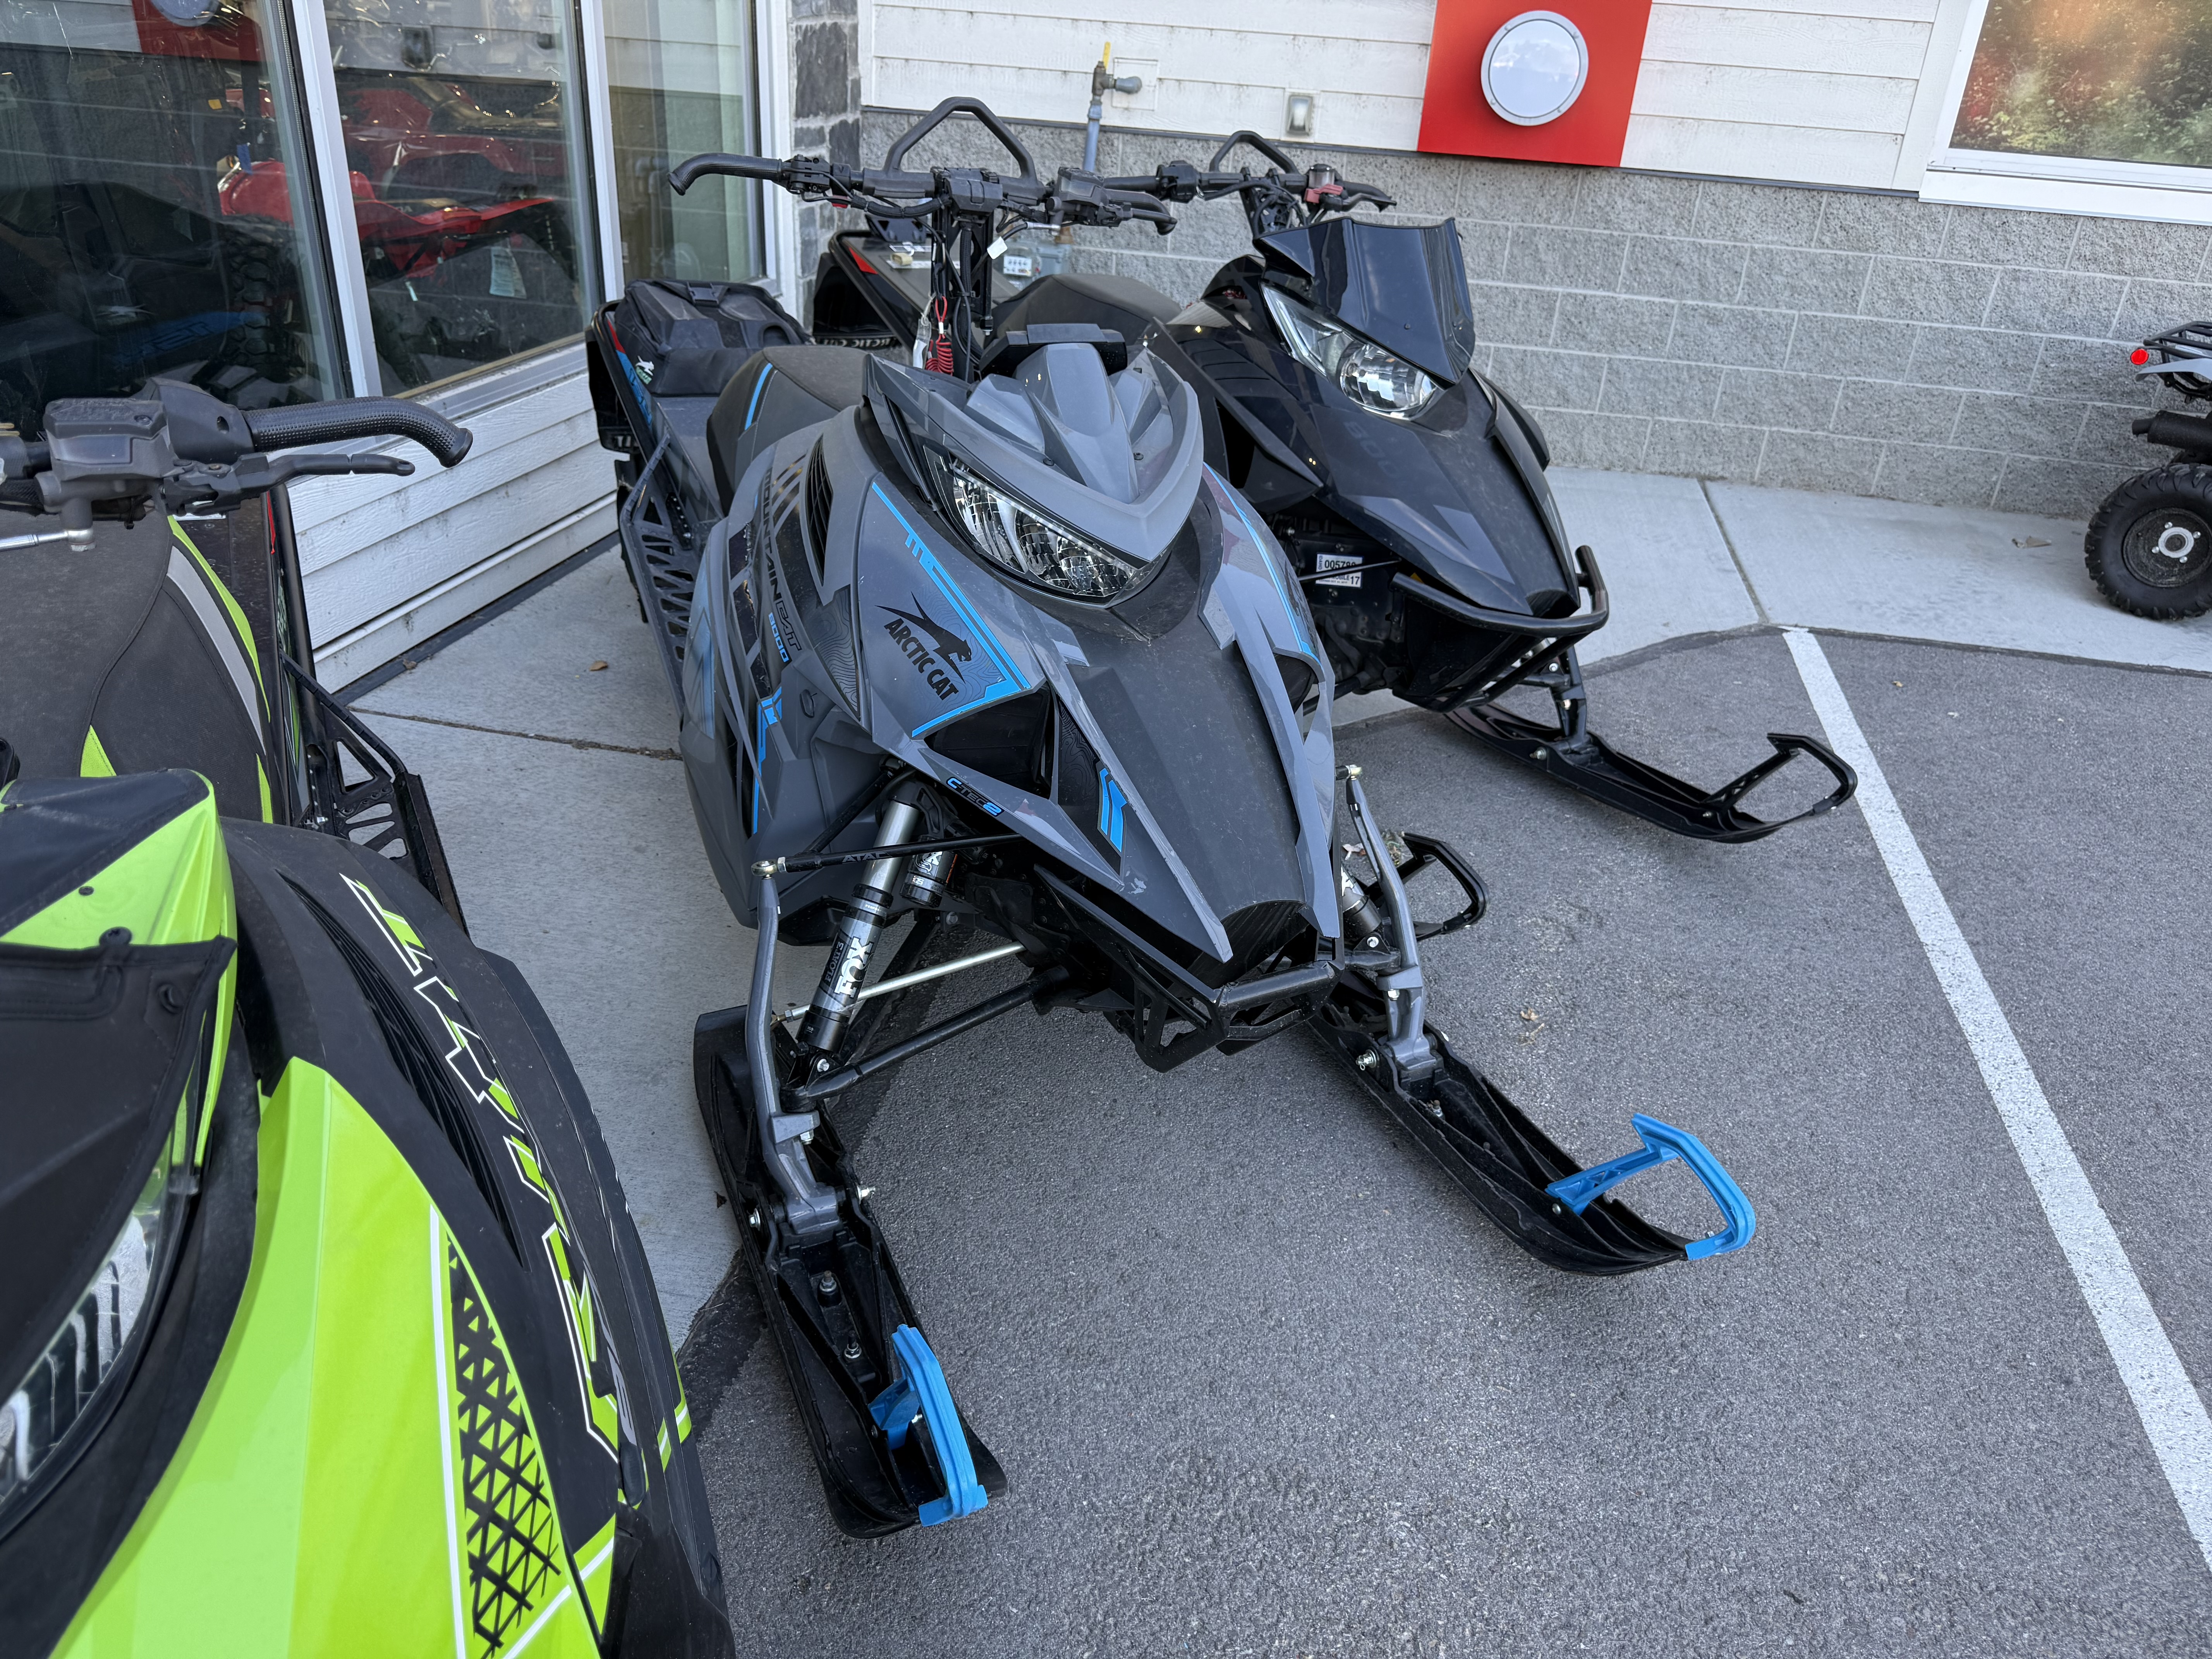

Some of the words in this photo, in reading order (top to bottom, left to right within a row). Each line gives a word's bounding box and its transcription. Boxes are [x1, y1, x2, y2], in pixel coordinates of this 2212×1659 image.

[1350, 576, 1360, 585] 17
[768, 612, 789, 662] 8000
[776, 600, 802, 651] CAT
[884, 618, 936, 673] ARCTIC
[927, 669, 959, 701] CAT
[842, 851, 889, 863] ATAC
[834, 936, 874, 998] FOX
